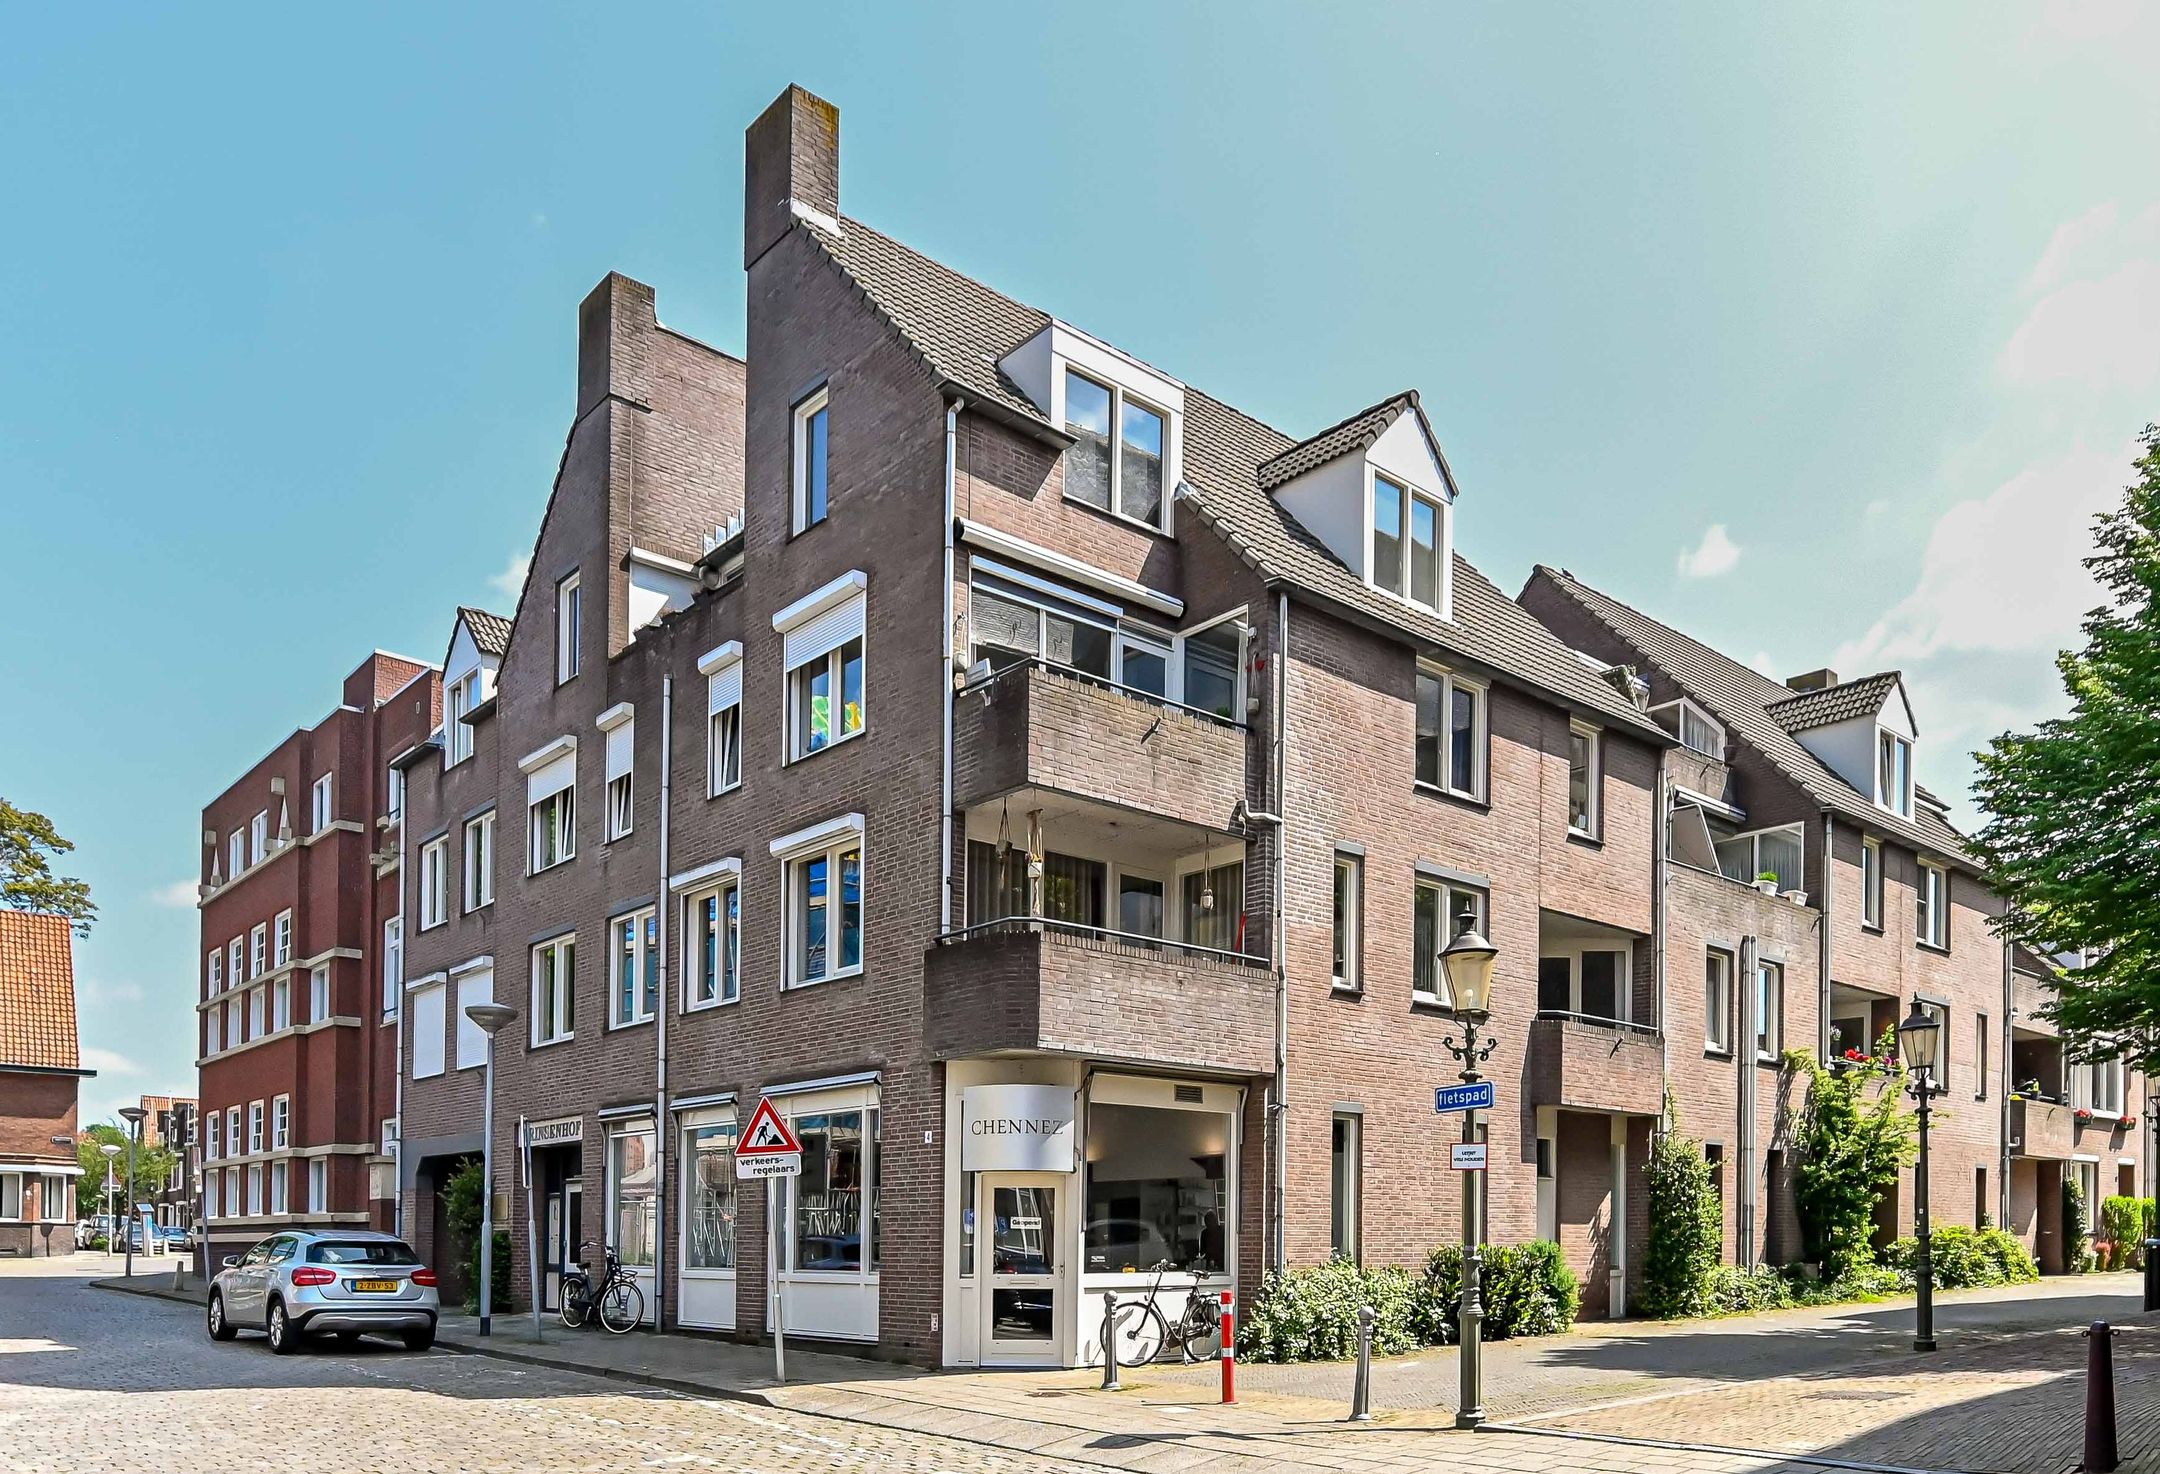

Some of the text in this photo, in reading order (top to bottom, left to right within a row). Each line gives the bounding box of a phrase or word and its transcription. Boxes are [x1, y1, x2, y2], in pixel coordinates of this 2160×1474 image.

[1439, 1087, 1487, 1105] fietspad
[527, 1120, 581, 1141] RINSENHOF
[971, 1119, 1064, 1135] CHENNEZ
[740, 1157, 784, 1166] verkeers-
[753, 1165, 795, 1176] regelaars
